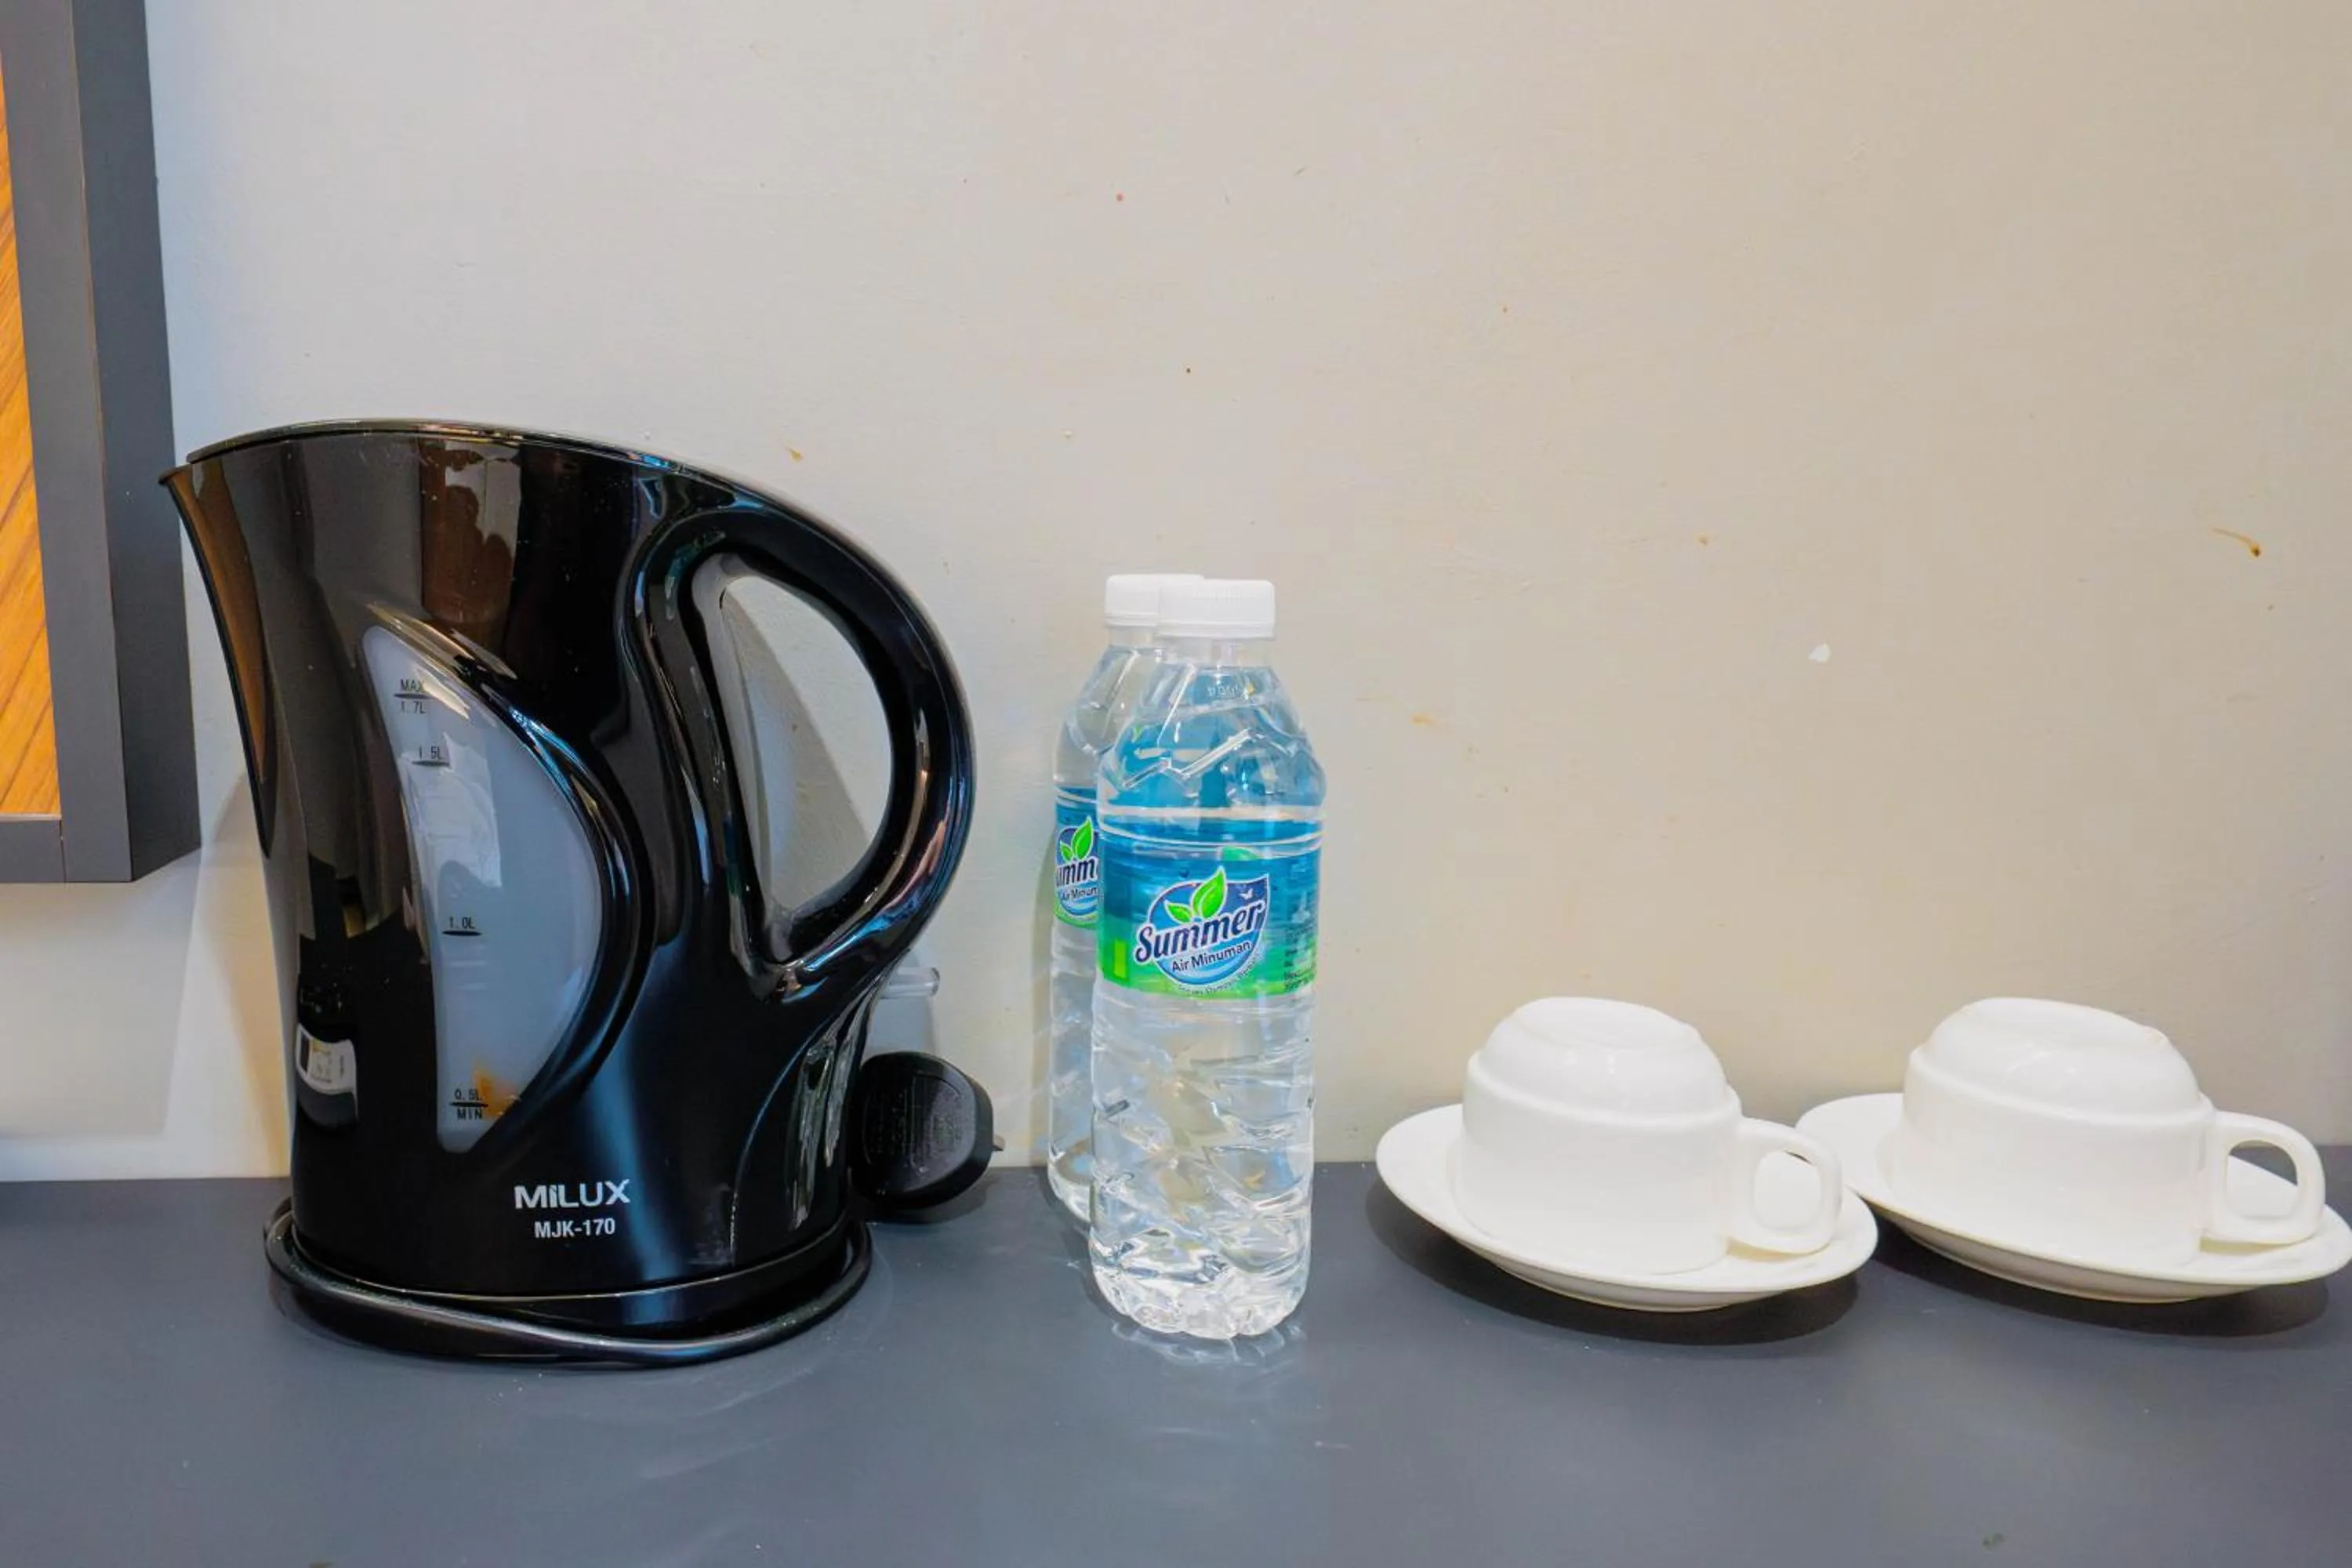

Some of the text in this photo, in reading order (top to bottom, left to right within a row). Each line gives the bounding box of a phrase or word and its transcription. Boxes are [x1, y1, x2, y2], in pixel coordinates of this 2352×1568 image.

[1134, 901, 1264, 964] Summer
[1171, 958, 1189, 972] Air
[1191, 941, 1250, 969] Minuman
[457, 1107, 483, 1120] MIN
[534, 1218, 616, 1239] MJK-170
